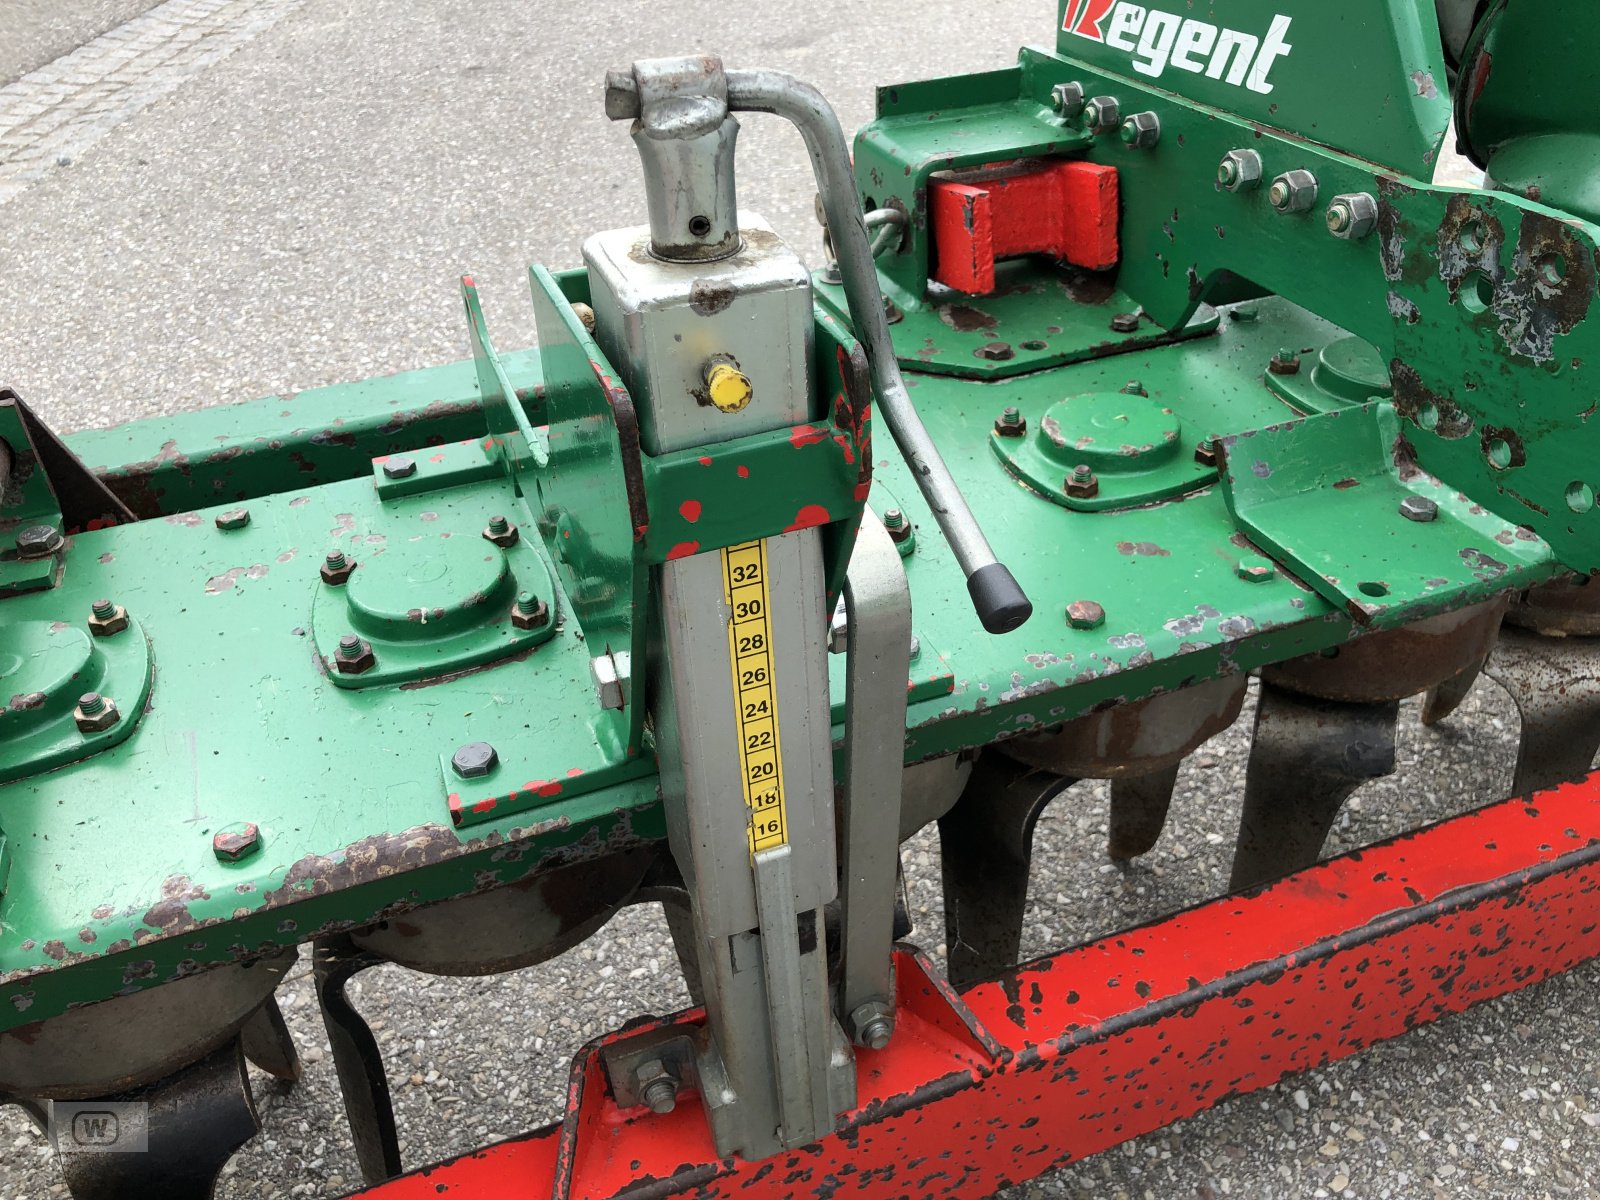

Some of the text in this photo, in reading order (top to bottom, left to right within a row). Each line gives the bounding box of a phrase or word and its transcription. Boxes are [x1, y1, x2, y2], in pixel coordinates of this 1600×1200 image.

[733, 563, 758, 583] 32
[736, 600, 761, 618] 30
[739, 634, 763, 653] 28
[742, 668, 766, 685] 26
[745, 700, 768, 718] 24
[748, 731, 771, 749] 22
[751, 762, 773, 779] 20
[757, 820, 779, 836] 16
